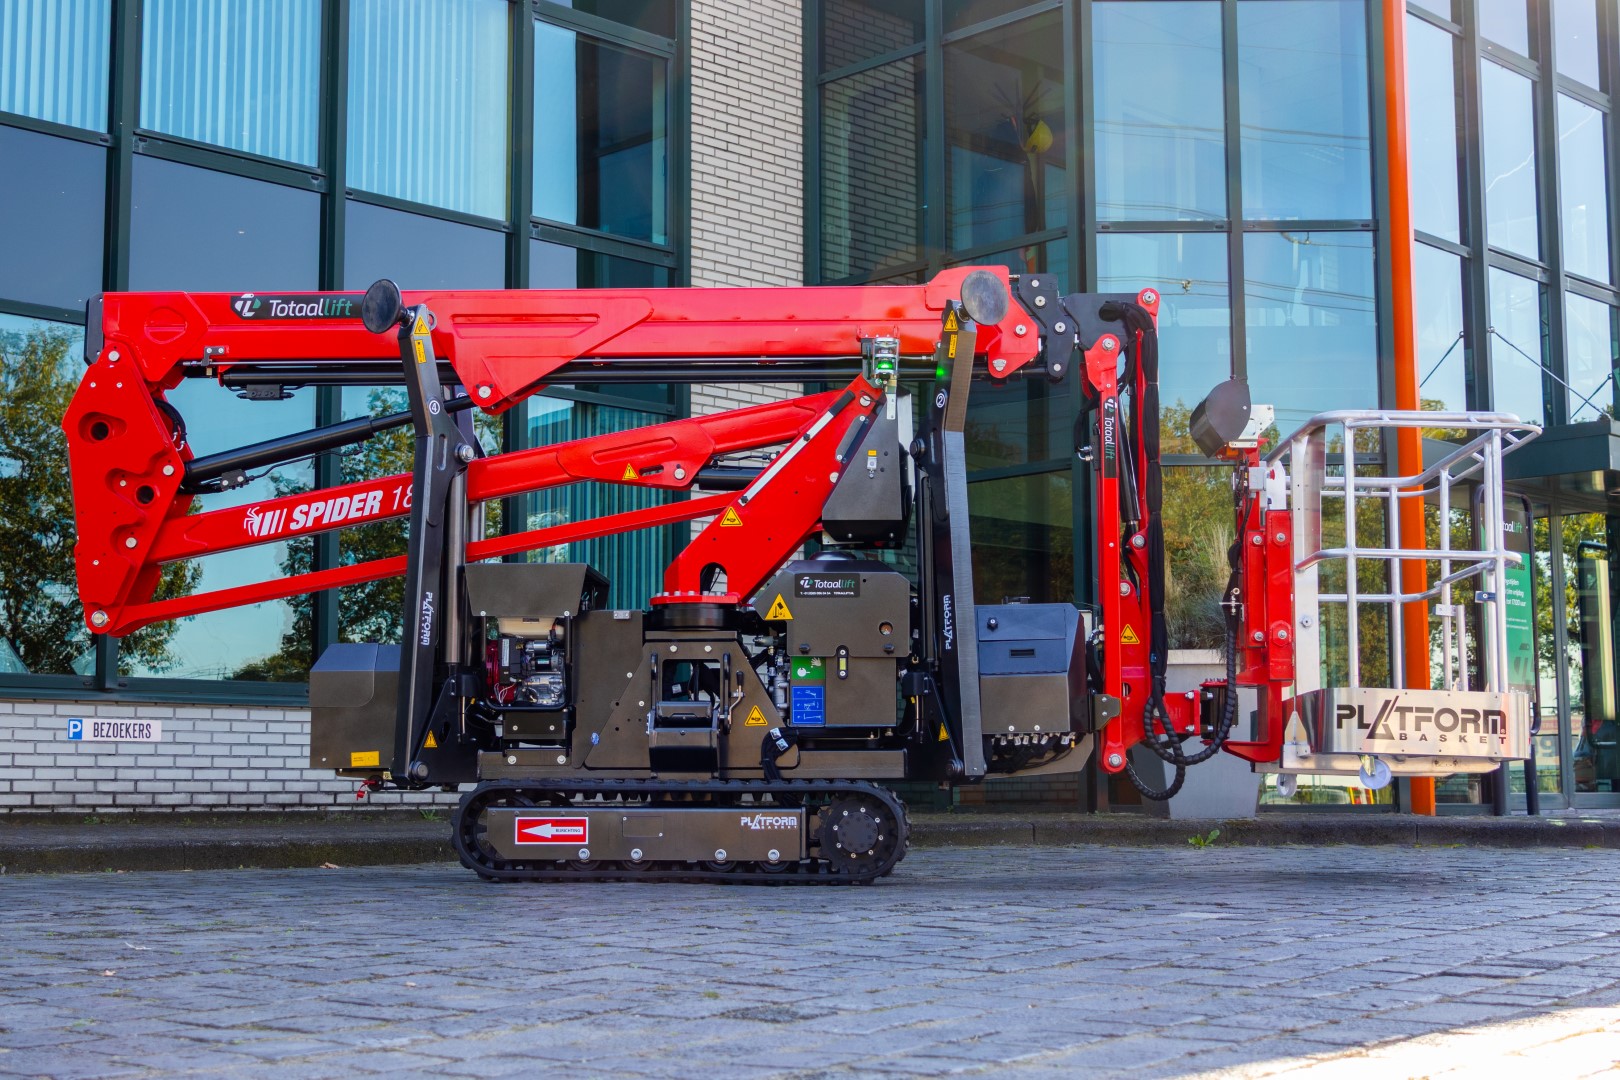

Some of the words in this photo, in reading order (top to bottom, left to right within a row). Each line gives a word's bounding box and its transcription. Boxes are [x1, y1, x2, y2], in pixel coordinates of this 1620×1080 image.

[269, 298, 352, 317] Totaallift
[1104, 416, 1115, 460] Totaallift
[289, 490, 383, 530] SPIDER
[814, 579, 855, 589] Totaallift
[422, 592, 434, 646] PLATFORM
[943, 595, 952, 650] PLATFORM
[69, 720, 82, 738] P
[93, 722, 152, 738] BEZOEKERS
[1336, 695, 1506, 740] PLATFORM
[1399, 733, 1506, 745] BASKET
[741, 813, 797, 829] PLATFORM
